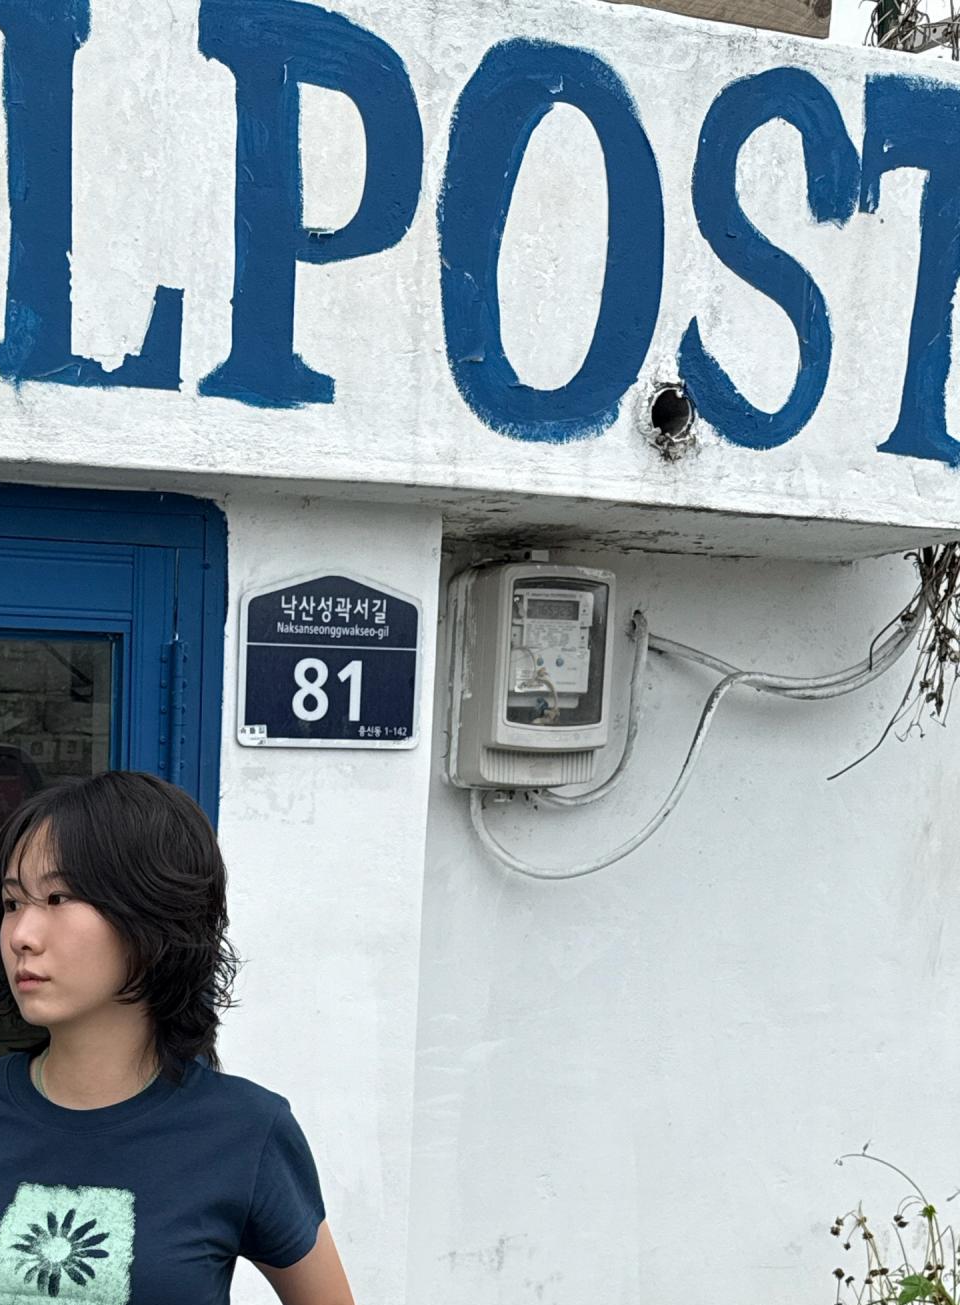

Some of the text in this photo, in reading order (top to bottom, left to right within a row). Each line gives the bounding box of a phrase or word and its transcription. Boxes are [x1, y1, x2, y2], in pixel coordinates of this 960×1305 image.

[281, 595, 387, 624] 낙산성곽서길
[277, 622, 389, 640] Naksanseonggwakseo-gil
[292, 657, 363, 722] 81
[384, 726, 408, 736] 1-142
